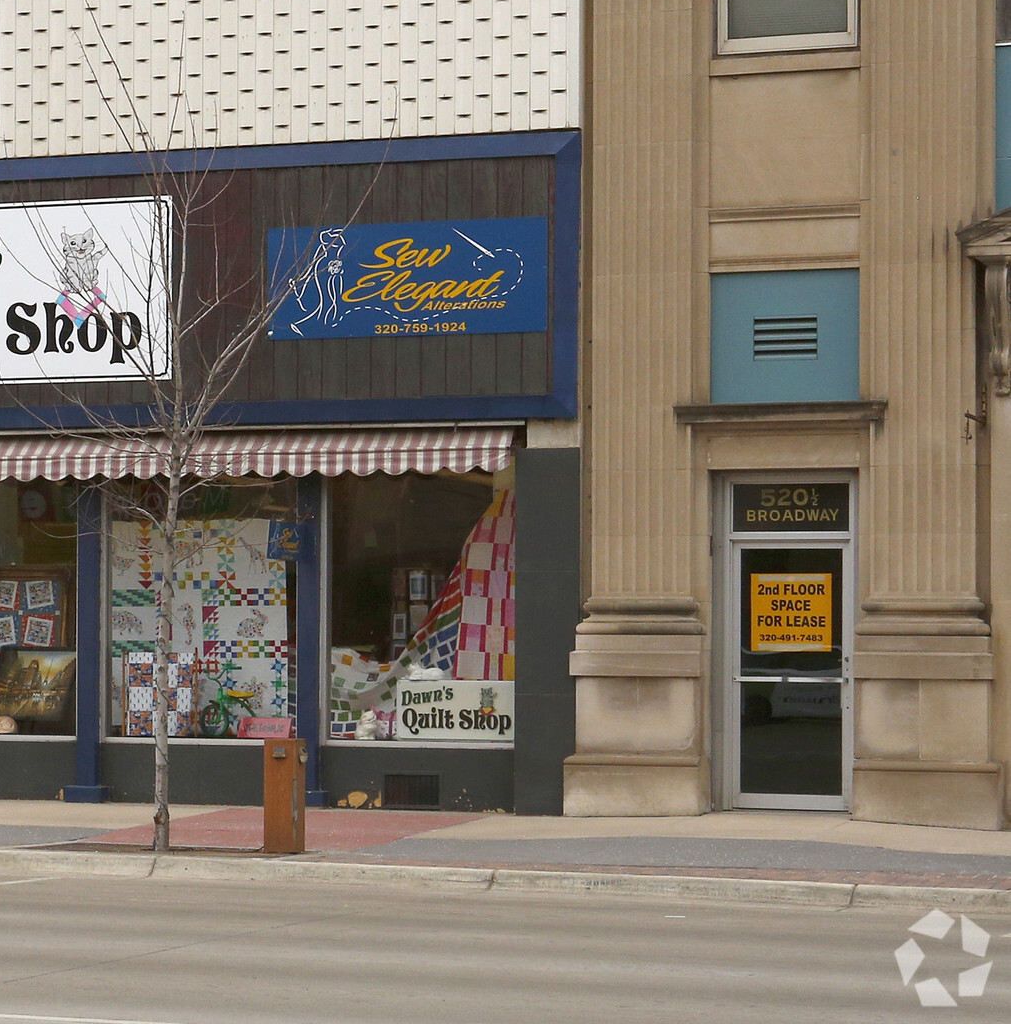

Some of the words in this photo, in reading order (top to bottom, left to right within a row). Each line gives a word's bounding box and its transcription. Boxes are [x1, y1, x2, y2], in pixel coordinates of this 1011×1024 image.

[358, 238, 451, 268] Sew
[341, 270, 505, 312] Elegant
[421, 299, 506, 311] Alterations
[6, 302, 142, 365] Shop
[374, 322, 466, 334] 320-759-1924
[746, 509, 839, 522] BROADWAY
[758, 584, 779, 595] 2nd
[784, 584, 825, 595] FLOOR
[771, 600, 811, 611] SPACE
[758, 616, 782, 627] FOR
[786, 616, 826, 627] LEASE
[401, 686, 454, 706] Dawn's
[402, 707, 455, 735] Quilt
[459, 709, 512, 735] Shop
